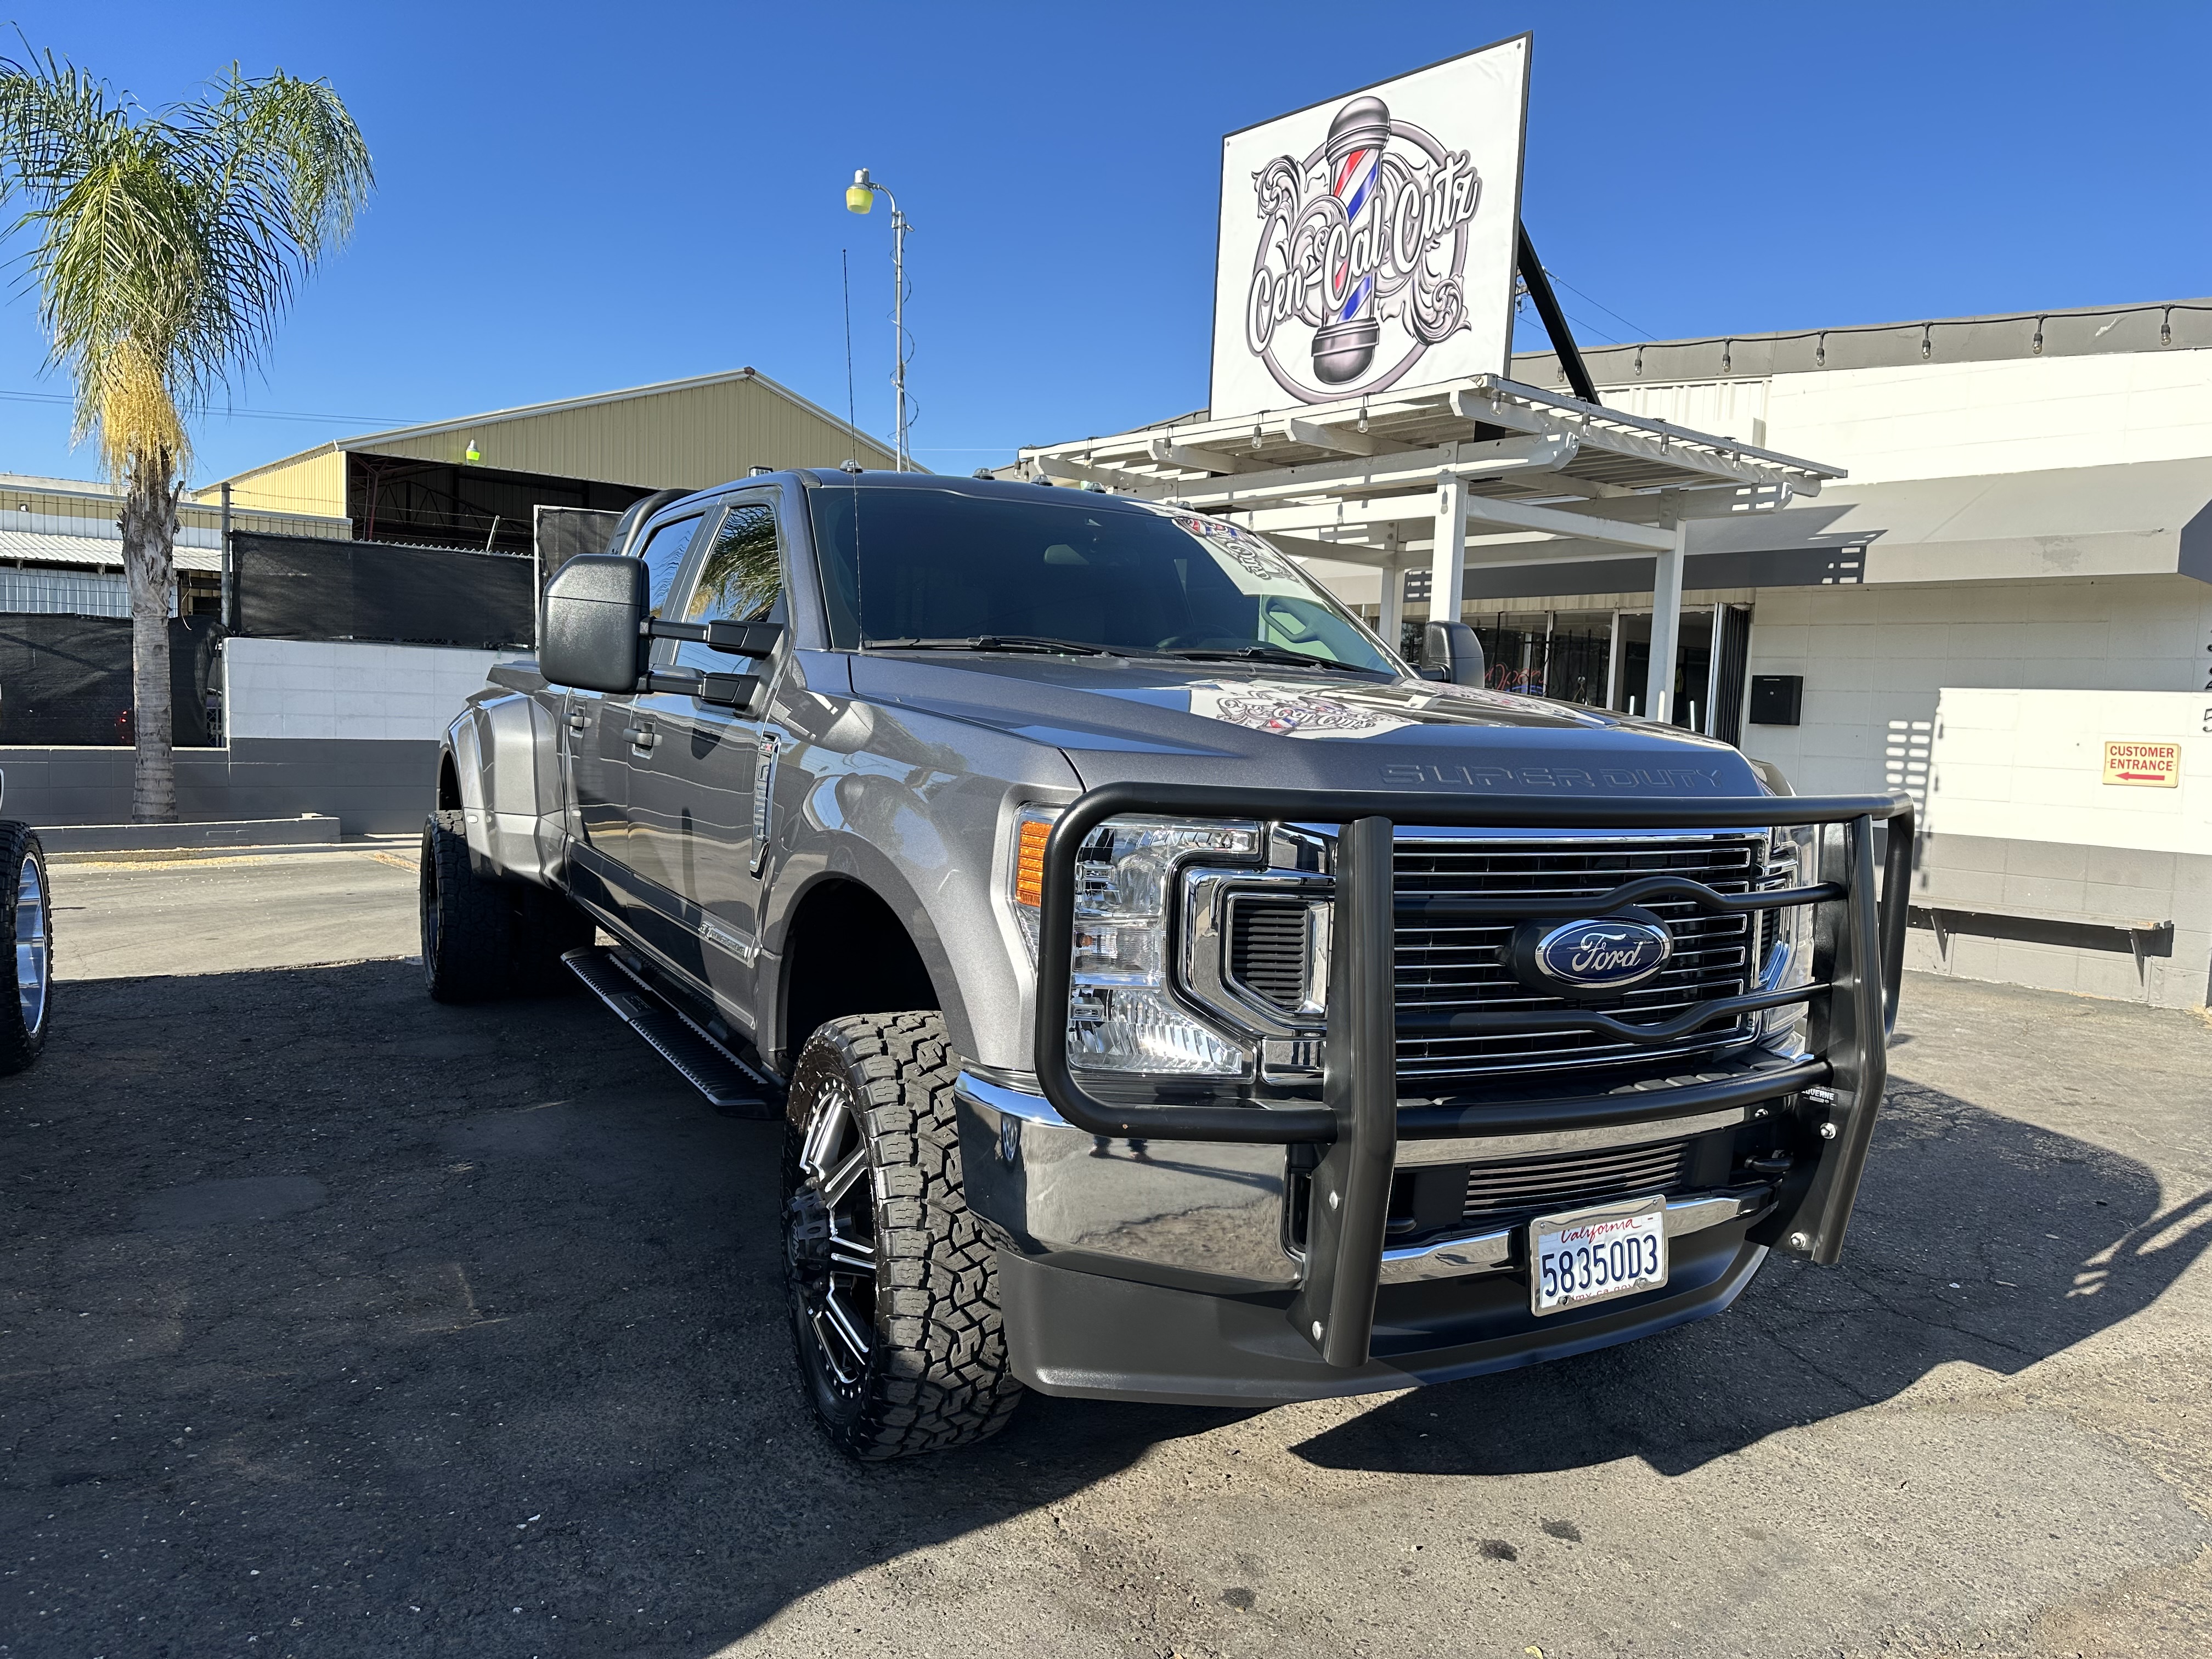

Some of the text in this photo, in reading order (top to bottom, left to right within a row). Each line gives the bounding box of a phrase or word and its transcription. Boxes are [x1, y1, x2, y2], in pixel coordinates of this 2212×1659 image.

[1391, 151, 1480, 275] Cutz
[2110, 746, 2174, 758] CUSTOMER
[1379, 764, 1722, 788] SUPER DUTY
[2110, 759, 2173, 771] ENTRANCE
[1572, 933, 1644, 972] Ford
[1801, 1088, 1835, 1101] UVERNE
[1561, 1218, 1642, 1244] California
[1542, 1234, 1658, 1297] 58350D3
